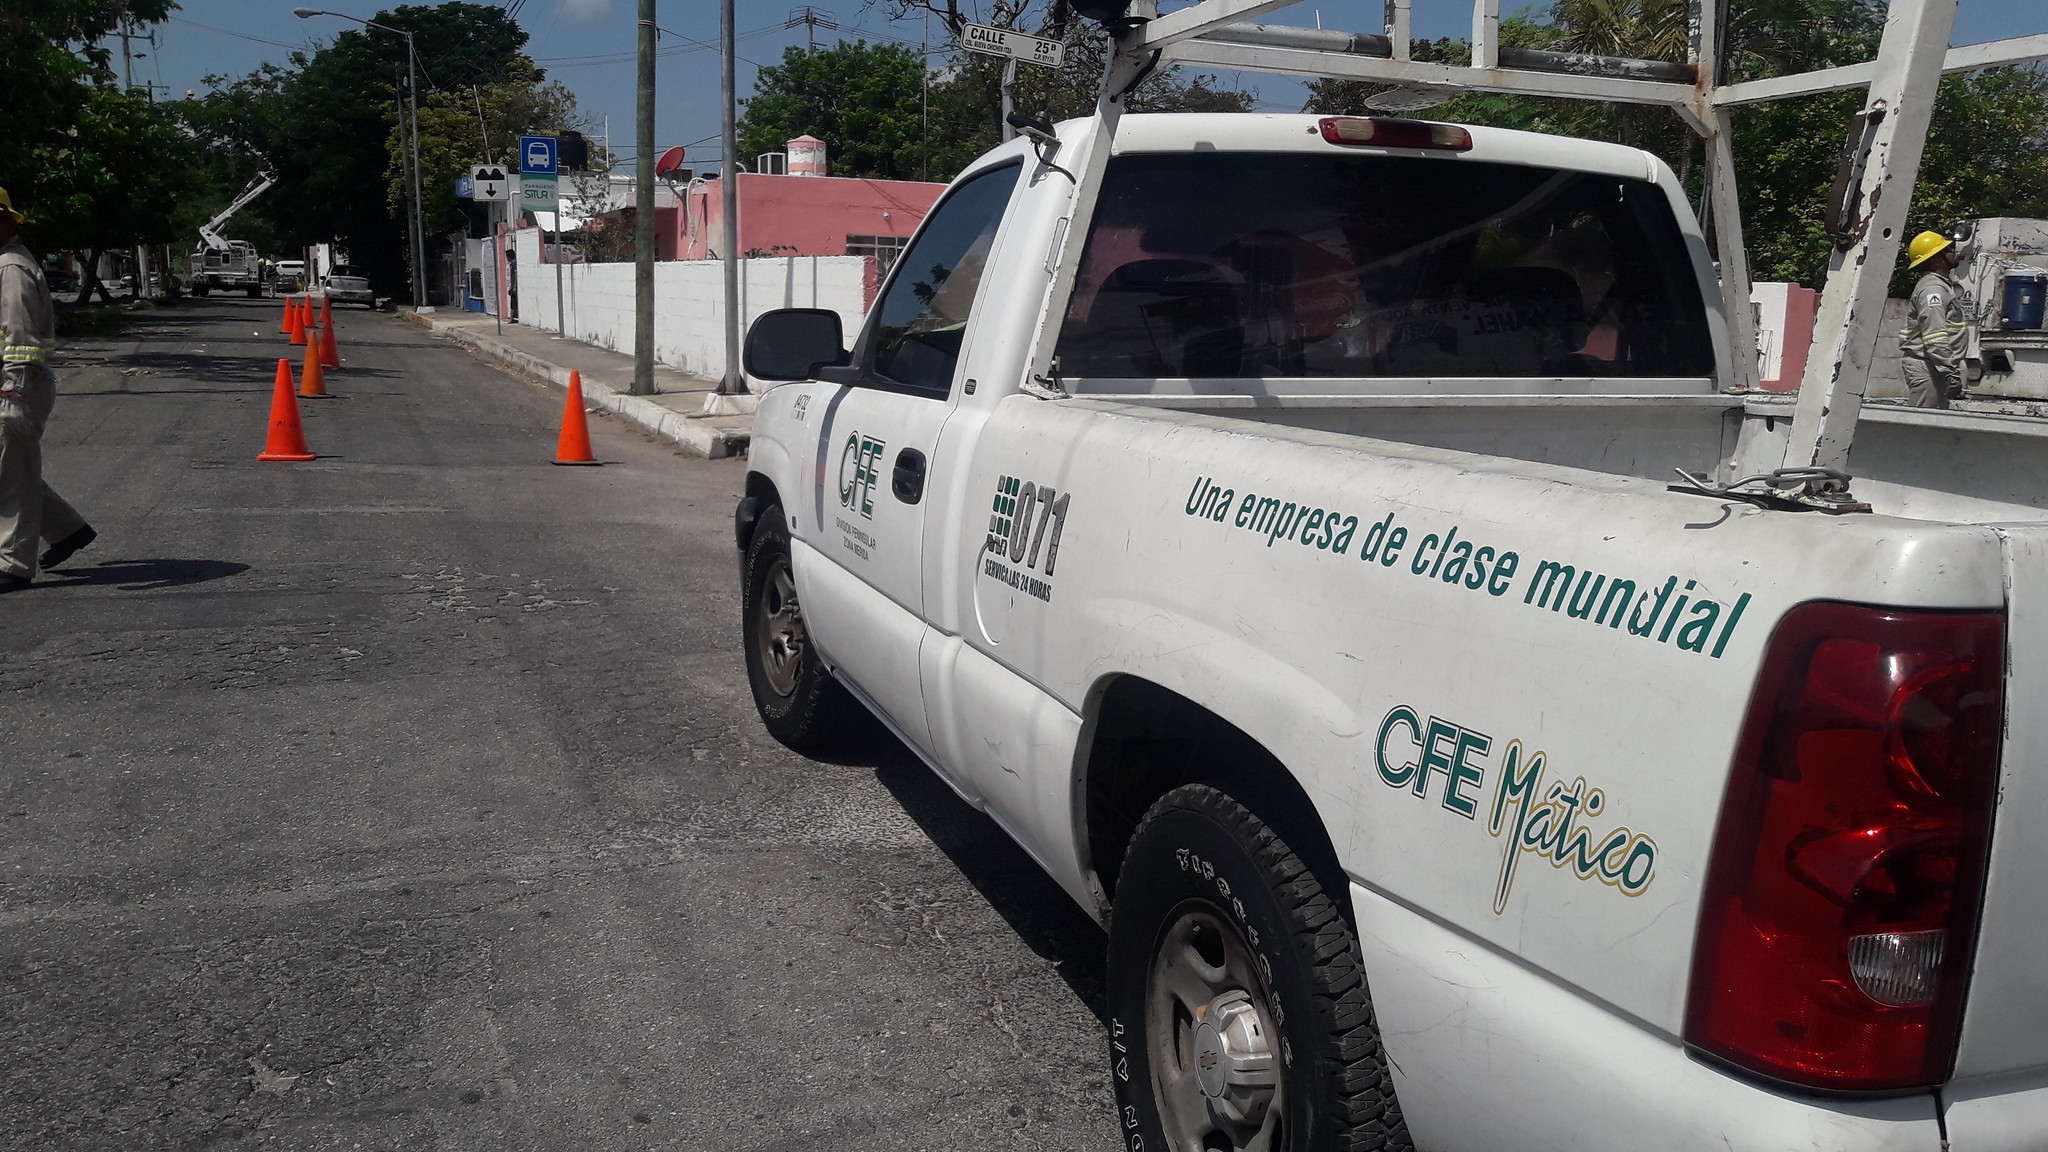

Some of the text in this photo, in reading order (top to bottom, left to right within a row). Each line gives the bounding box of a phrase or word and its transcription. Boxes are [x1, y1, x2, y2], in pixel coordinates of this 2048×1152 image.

[964, 39, 973, 48] COL.
[971, 27, 1006, 45] CALLE
[840, 429, 887, 521] CFE
[1009, 480, 1071, 577] 071
[1184, 475, 1753, 661] Una empresa de clase mundial
[1020, 574, 1029, 593] 24
[1028, 577, 1052, 603] HORAS
[1374, 704, 1493, 820] CFE
